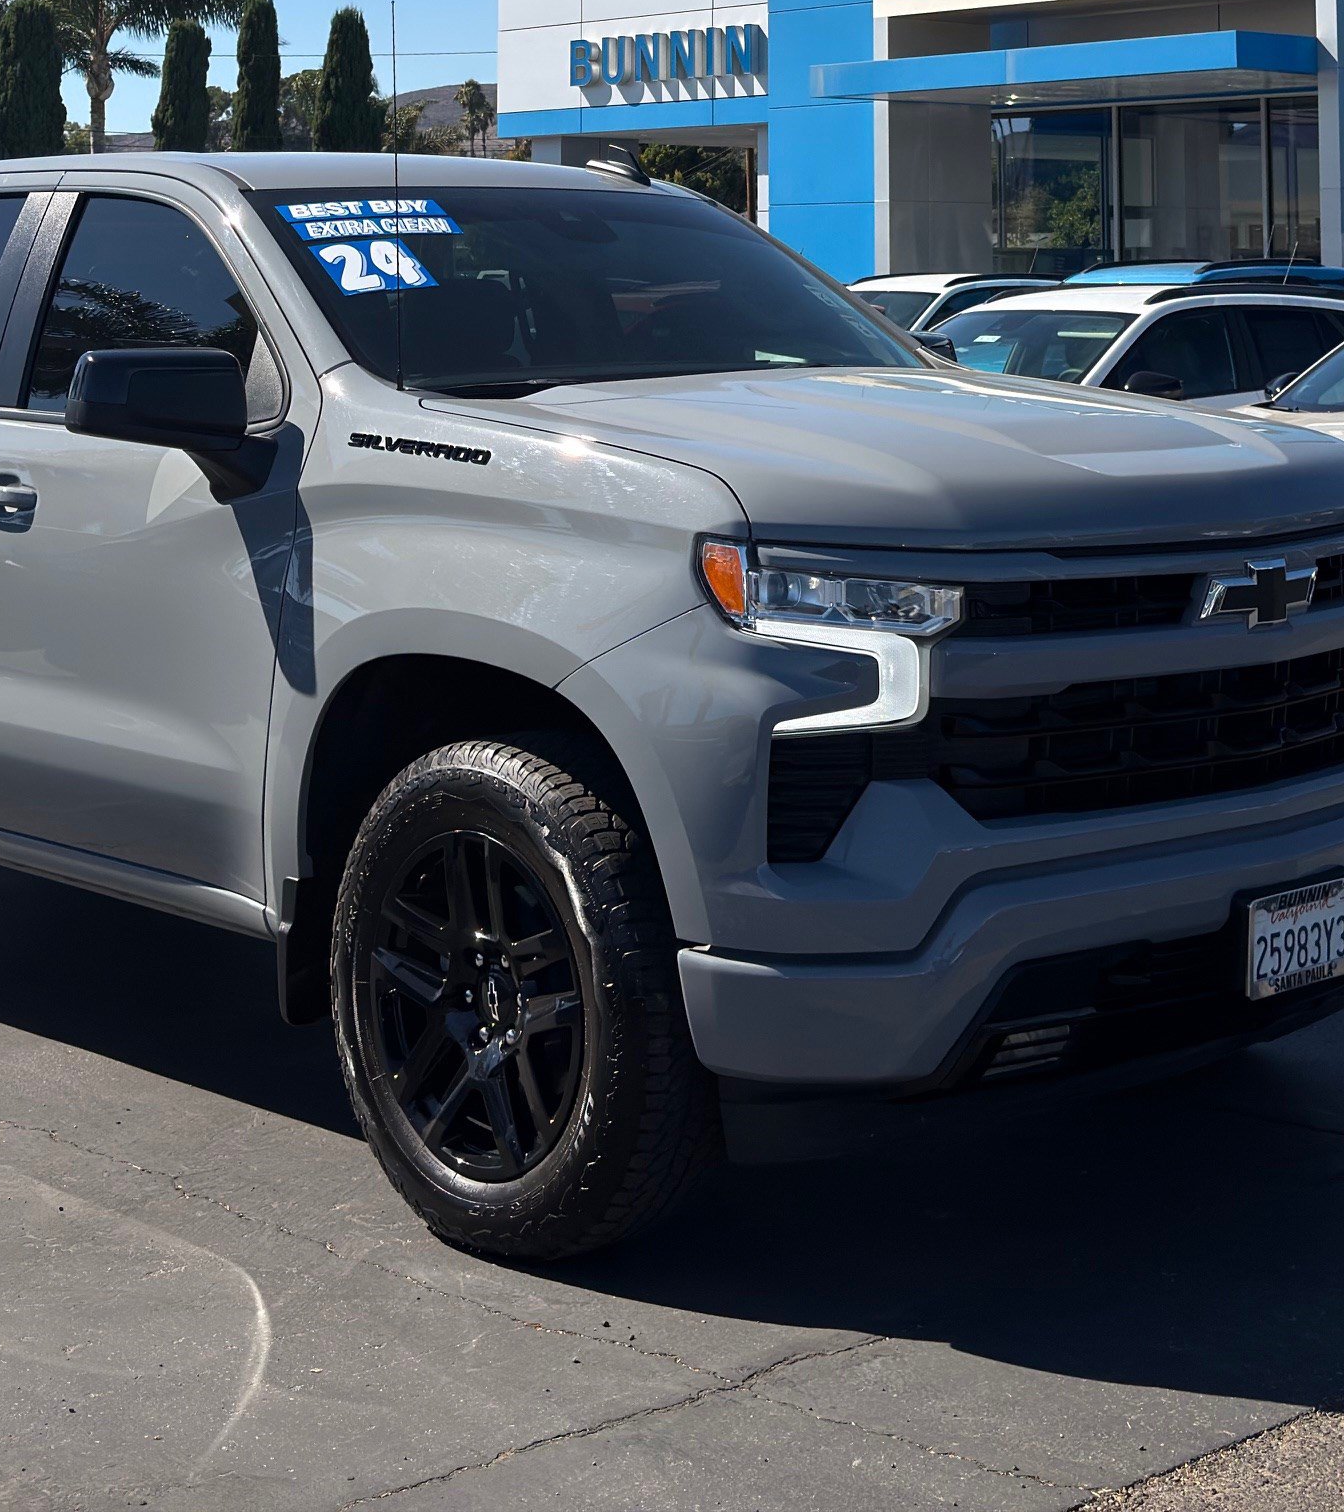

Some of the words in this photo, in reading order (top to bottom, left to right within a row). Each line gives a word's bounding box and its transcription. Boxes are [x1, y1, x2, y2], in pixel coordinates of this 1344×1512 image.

[569, 23, 759, 87] BUNNIN
[288, 201, 363, 219] BEST
[367, 199, 428, 214] BUY
[305, 217, 380, 238] EXTRA
[380, 216, 452, 235] CLEAN
[319, 240, 427, 292] 24
[347, 432, 492, 466] SILVERADO
[1274, 972, 1303, 992] SANTA
[1305, 964, 1334, 985] PAULA
